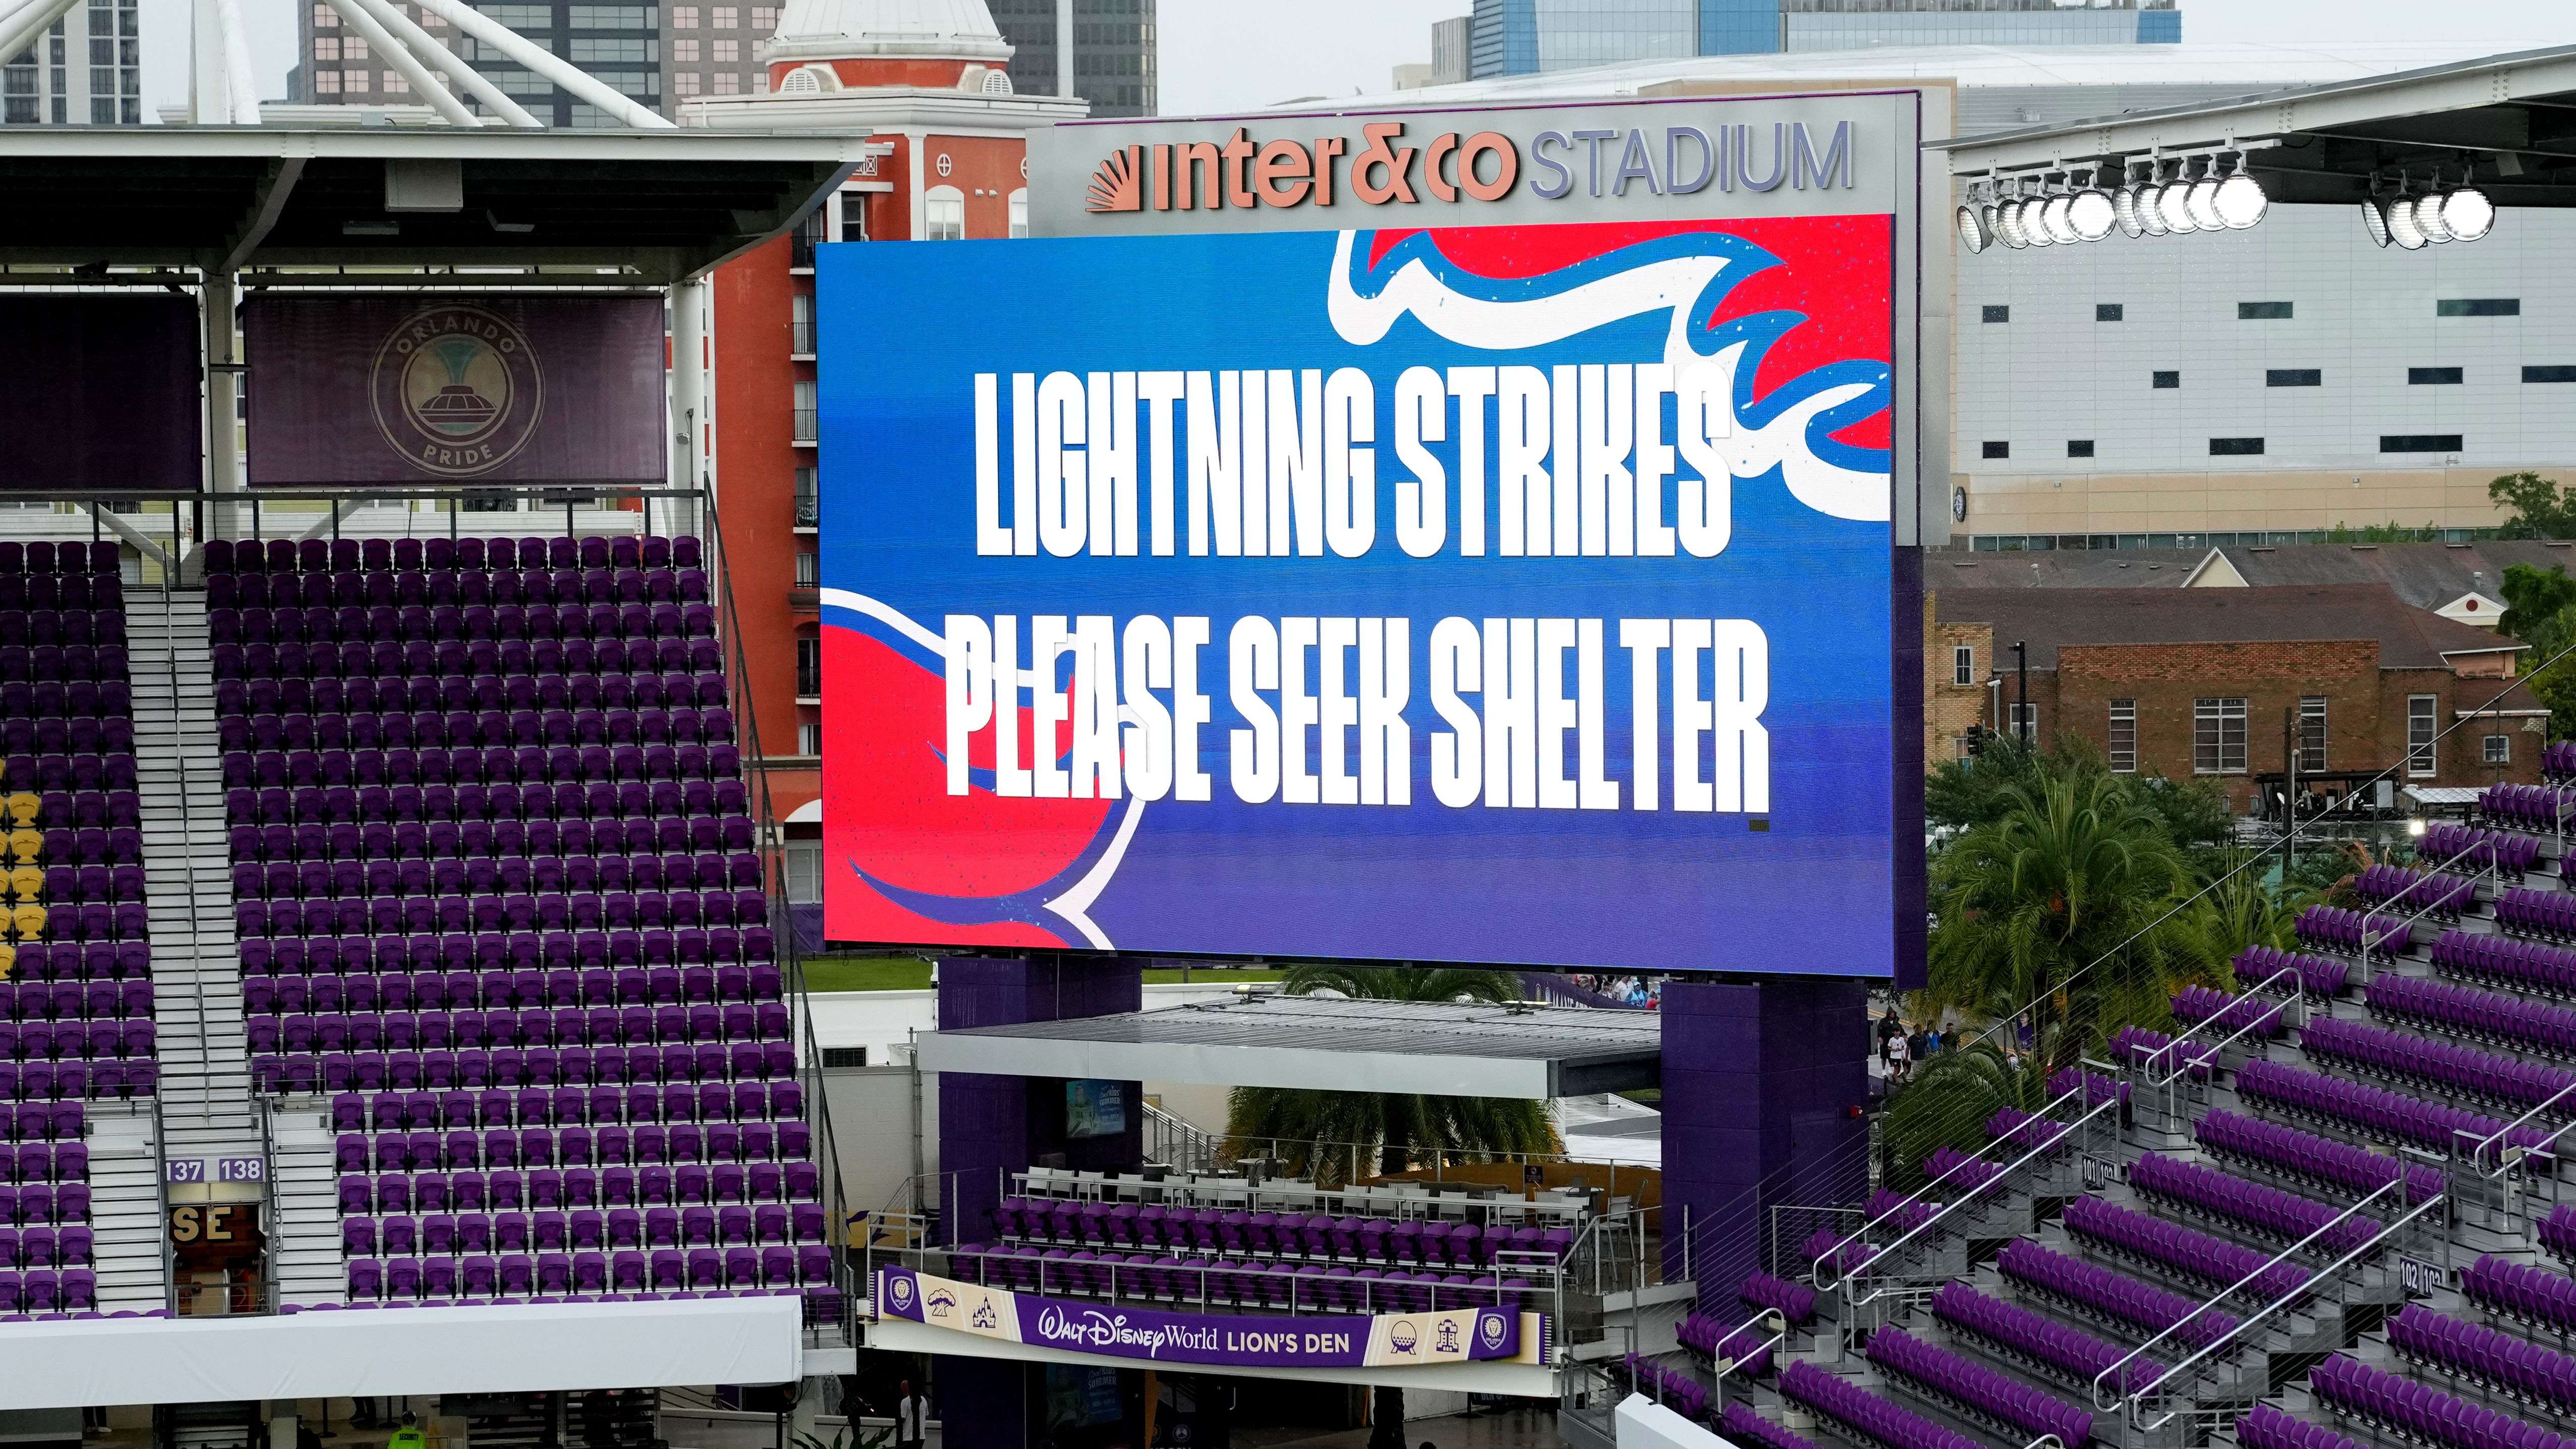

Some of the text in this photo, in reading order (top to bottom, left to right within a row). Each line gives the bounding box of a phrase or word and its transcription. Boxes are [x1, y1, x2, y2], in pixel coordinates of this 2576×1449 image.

[1530, 120, 1854, 198] STADIUM
[397, 315, 515, 354] ORLANDO
[423, 444, 493, 465] PRIDE
[975, 362, 1732, 558] LIGHTNING STRIKES
[945, 614, 1769, 814] PLEASE SEEK SHELTER
[222, 1160, 260, 1180] 138
[2083, 1158, 2096, 1182] 101
[2401, 1261, 2418, 1289] 102
[1306, 1333, 1349, 1353] DEN
